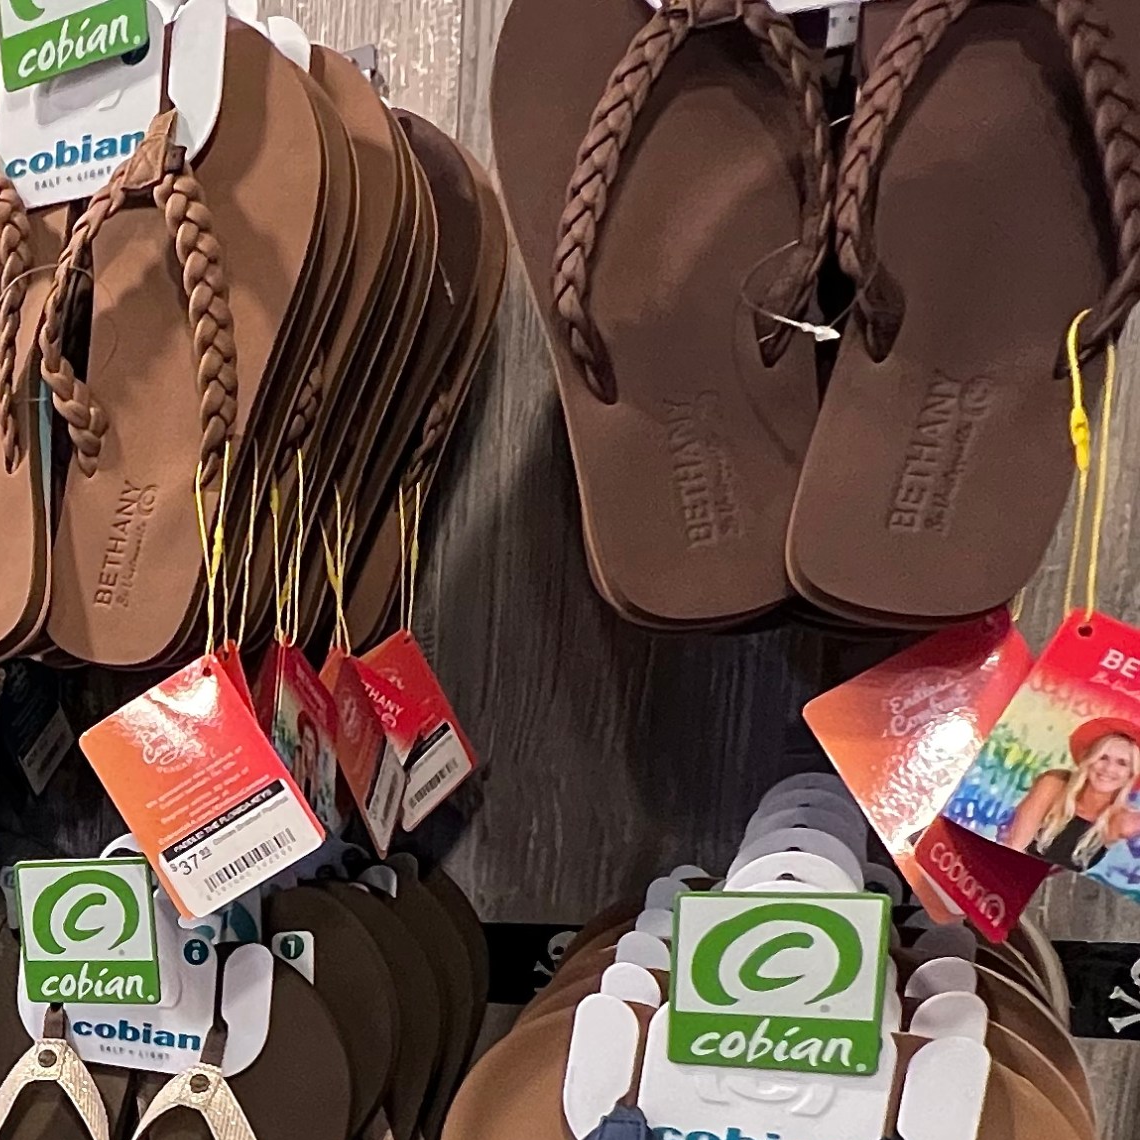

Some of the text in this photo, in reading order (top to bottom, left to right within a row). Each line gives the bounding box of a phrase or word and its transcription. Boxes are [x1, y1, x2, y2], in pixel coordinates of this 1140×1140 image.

[18, 14, 132, 78] cobian
[6, 131, 145, 179] cobian
[890, 376, 960, 533] BETHANY
[94, 479, 142, 609] BETHANY
[40, 963, 144, 999] cobian
[73, 1018, 201, 1052] cobian
[691, 1017, 854, 1067] cobian
